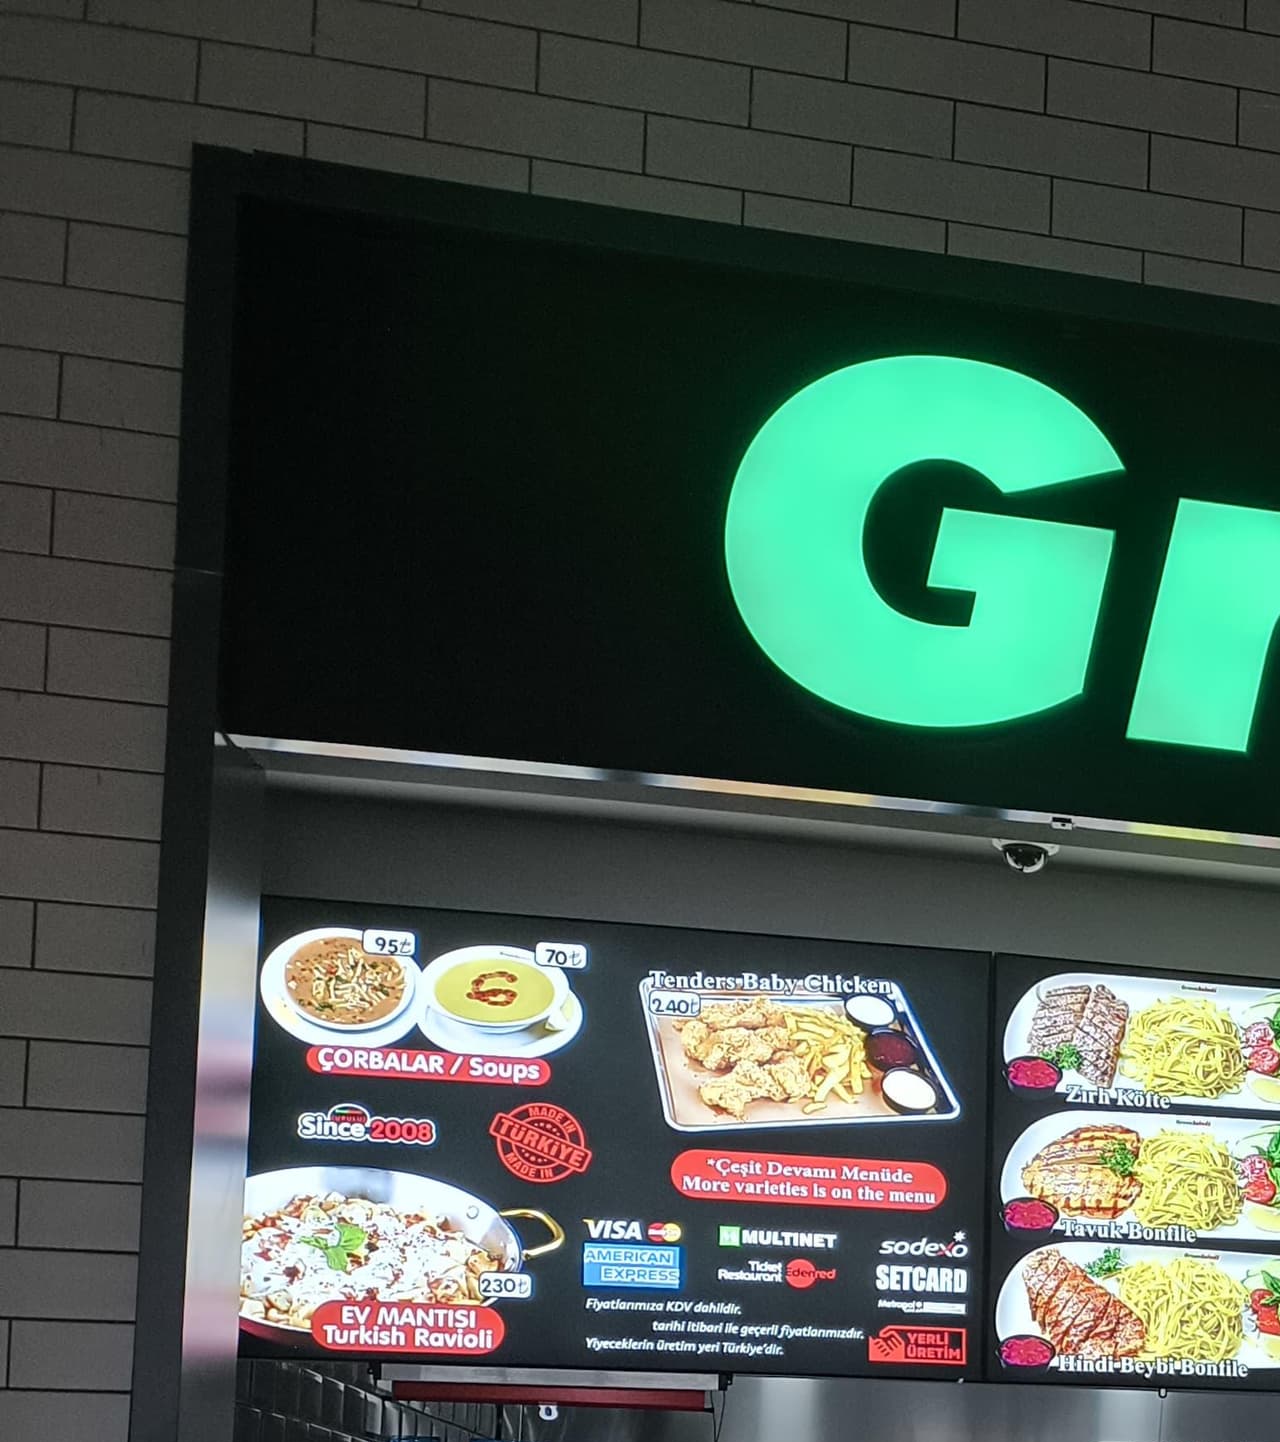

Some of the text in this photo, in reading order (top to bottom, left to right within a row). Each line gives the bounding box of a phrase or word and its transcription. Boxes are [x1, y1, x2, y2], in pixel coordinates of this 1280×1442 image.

[649, 970, 892, 995] Tenders Baby Chicken
[317, 1047, 541, 1084] ÇORBALAR Soups
[1115, 1087, 1172, 1109] Köfte
[528, 1106, 564, 1122] MADE
[301, 1114, 432, 1143] Since 2008
[505, 1151, 538, 1178] MADE
[767, 1161, 913, 1184] Devamı Menüde
[682, 1176, 936, 1205] More varieties is on the menu
[583, 1219, 643, 1241] VISA
[742, 1230, 838, 1249] MULTINET
[1062, 1218, 1198, 1243] Tavuk Bonfile
[585, 1249, 671, 1264] AMERICAN
[879, 1237, 969, 1258] sodexo
[603, 1267, 680, 1282] EXPRESS
[718, 1269, 783, 1283] Restaurant
[748, 1260, 783, 1273] Ticket
[786, 1266, 837, 1280] Edenred
[876, 1264, 968, 1293] SETCARD
[341, 1306, 477, 1328] EV MANTISI
[665, 1301, 693, 1313] KDV
[324, 1325, 494, 1349] Turkish Ravioli
[652, 1320, 686, 1332] tarihi
[585, 1337, 654, 1351] Yiyeceklerin
[656, 1339, 695, 1353] üretim
[697, 1342, 720, 1355] yeri
[1058, 1354, 1249, 1379] Hindi Beybi Bonfile
